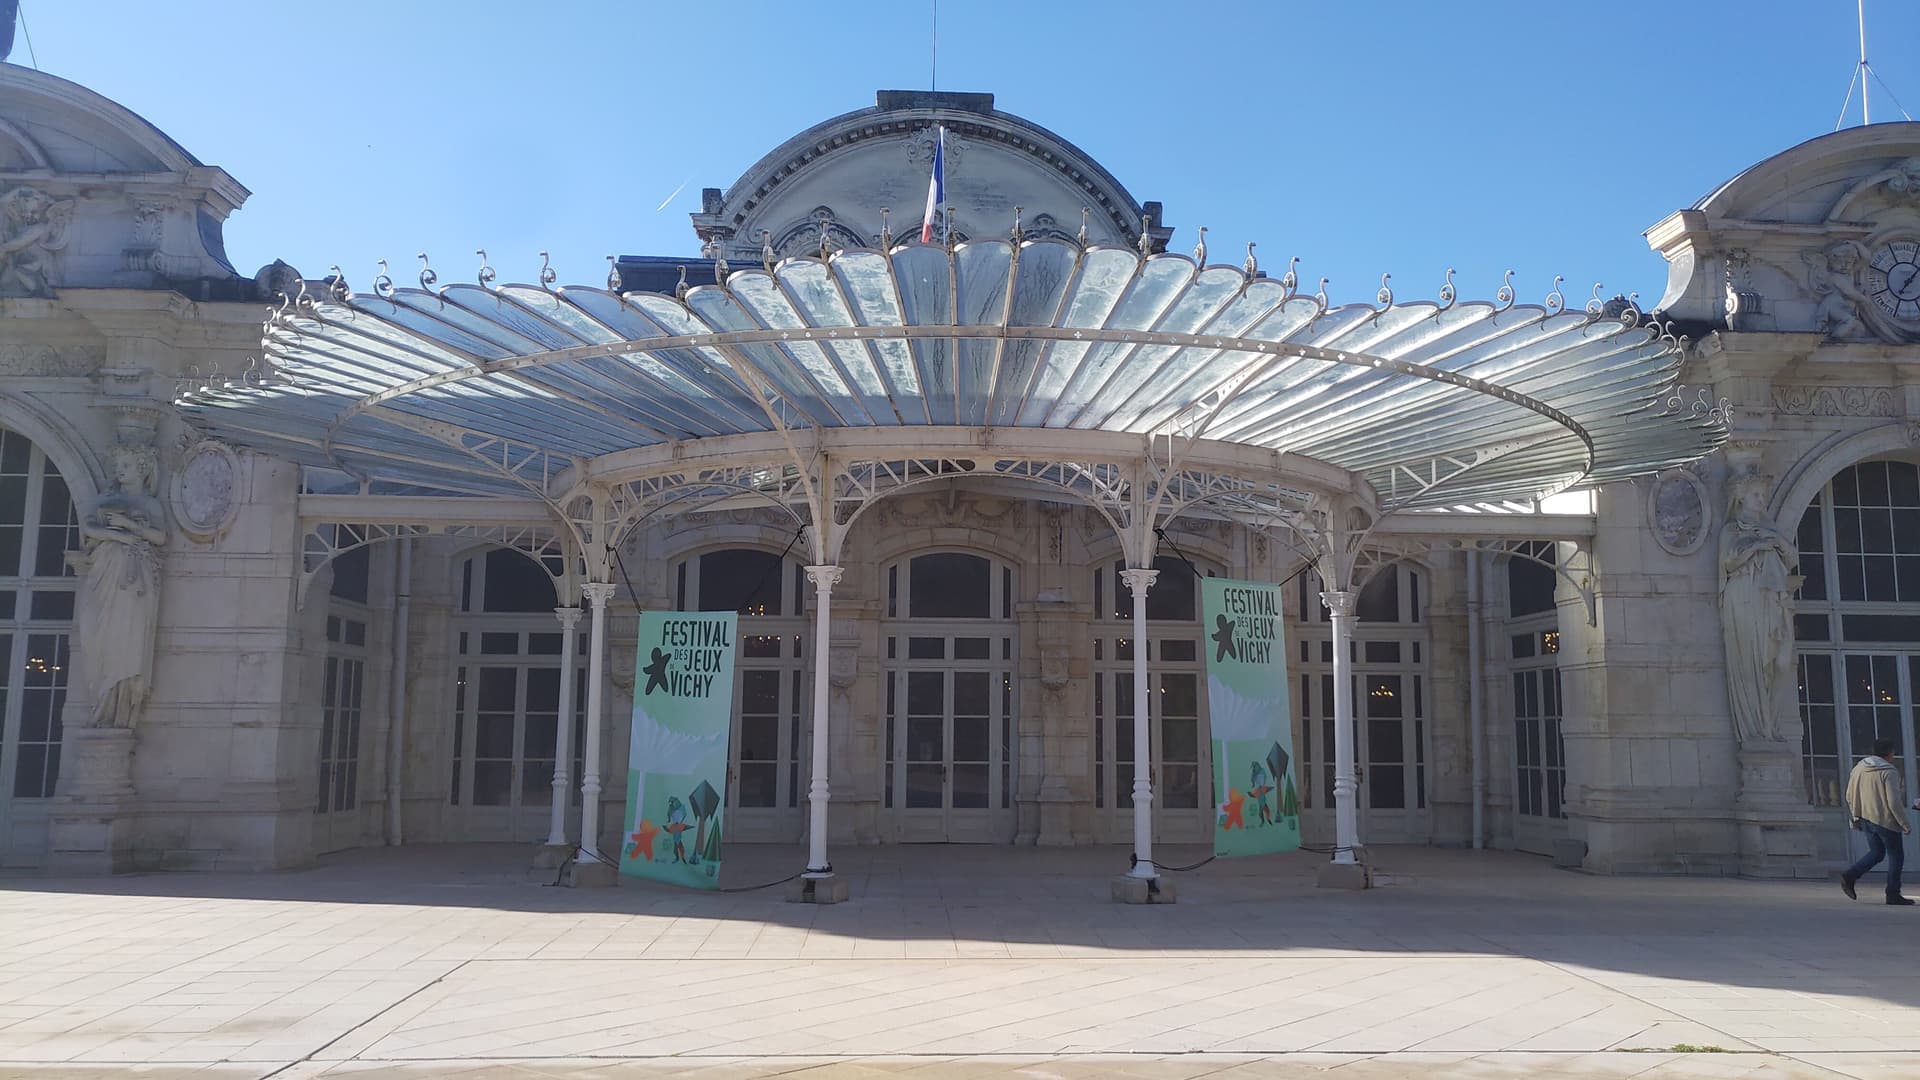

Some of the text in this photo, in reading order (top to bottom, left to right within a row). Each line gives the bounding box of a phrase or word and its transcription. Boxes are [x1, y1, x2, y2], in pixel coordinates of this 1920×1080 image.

[1224, 588, 1278, 616] FESTIVAL
[662, 621, 730, 647] FESTIVAL
[1237, 616, 1248, 628] DES
[1246, 617, 1275, 640] JEUX
[674, 649, 723, 673] DES JEUX
[1237, 637, 1271, 664] VICHY
[670, 670, 714, 698] VICHY
